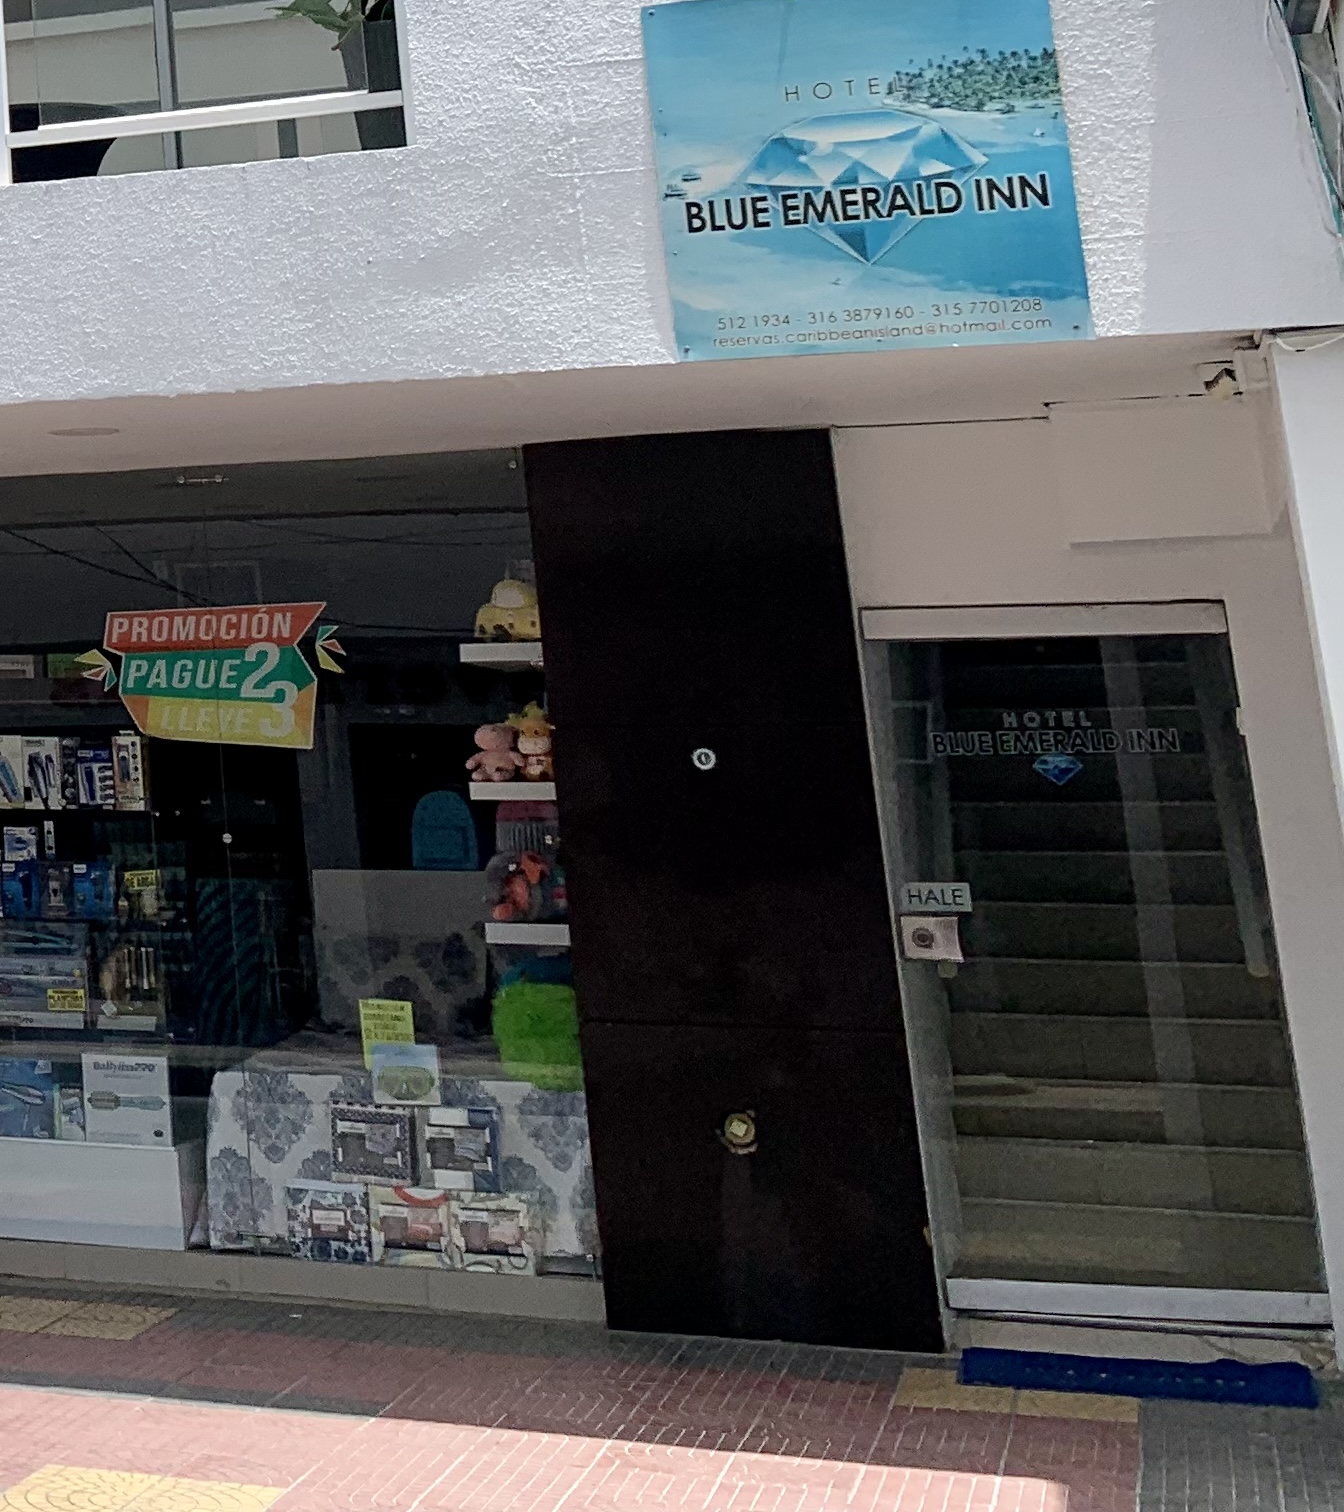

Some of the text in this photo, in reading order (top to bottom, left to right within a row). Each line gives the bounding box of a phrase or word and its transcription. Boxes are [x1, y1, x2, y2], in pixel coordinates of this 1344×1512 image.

[784, 76, 906, 103] HOTEL
[685, 173, 1051, 234] BLUE EMERALD INN
[718, 316, 746, 330] 512
[754, 314, 791, 328] 1934
[807, 311, 837, 325] 316
[843, 305, 915, 323] 3879160
[931, 302, 962, 317] 315
[968, 297, 1043, 315] 7701208
[111, 608, 293, 643] PROMOCIÓN
[126, 642, 280, 698] PAGUE 2
[160, 680, 299, 738] LLEVE 3
[1002, 710, 1092, 728] HOTEL
[931, 728, 1181, 755] BLUE EMERALD INN
[907, 889, 965, 906] HALE
